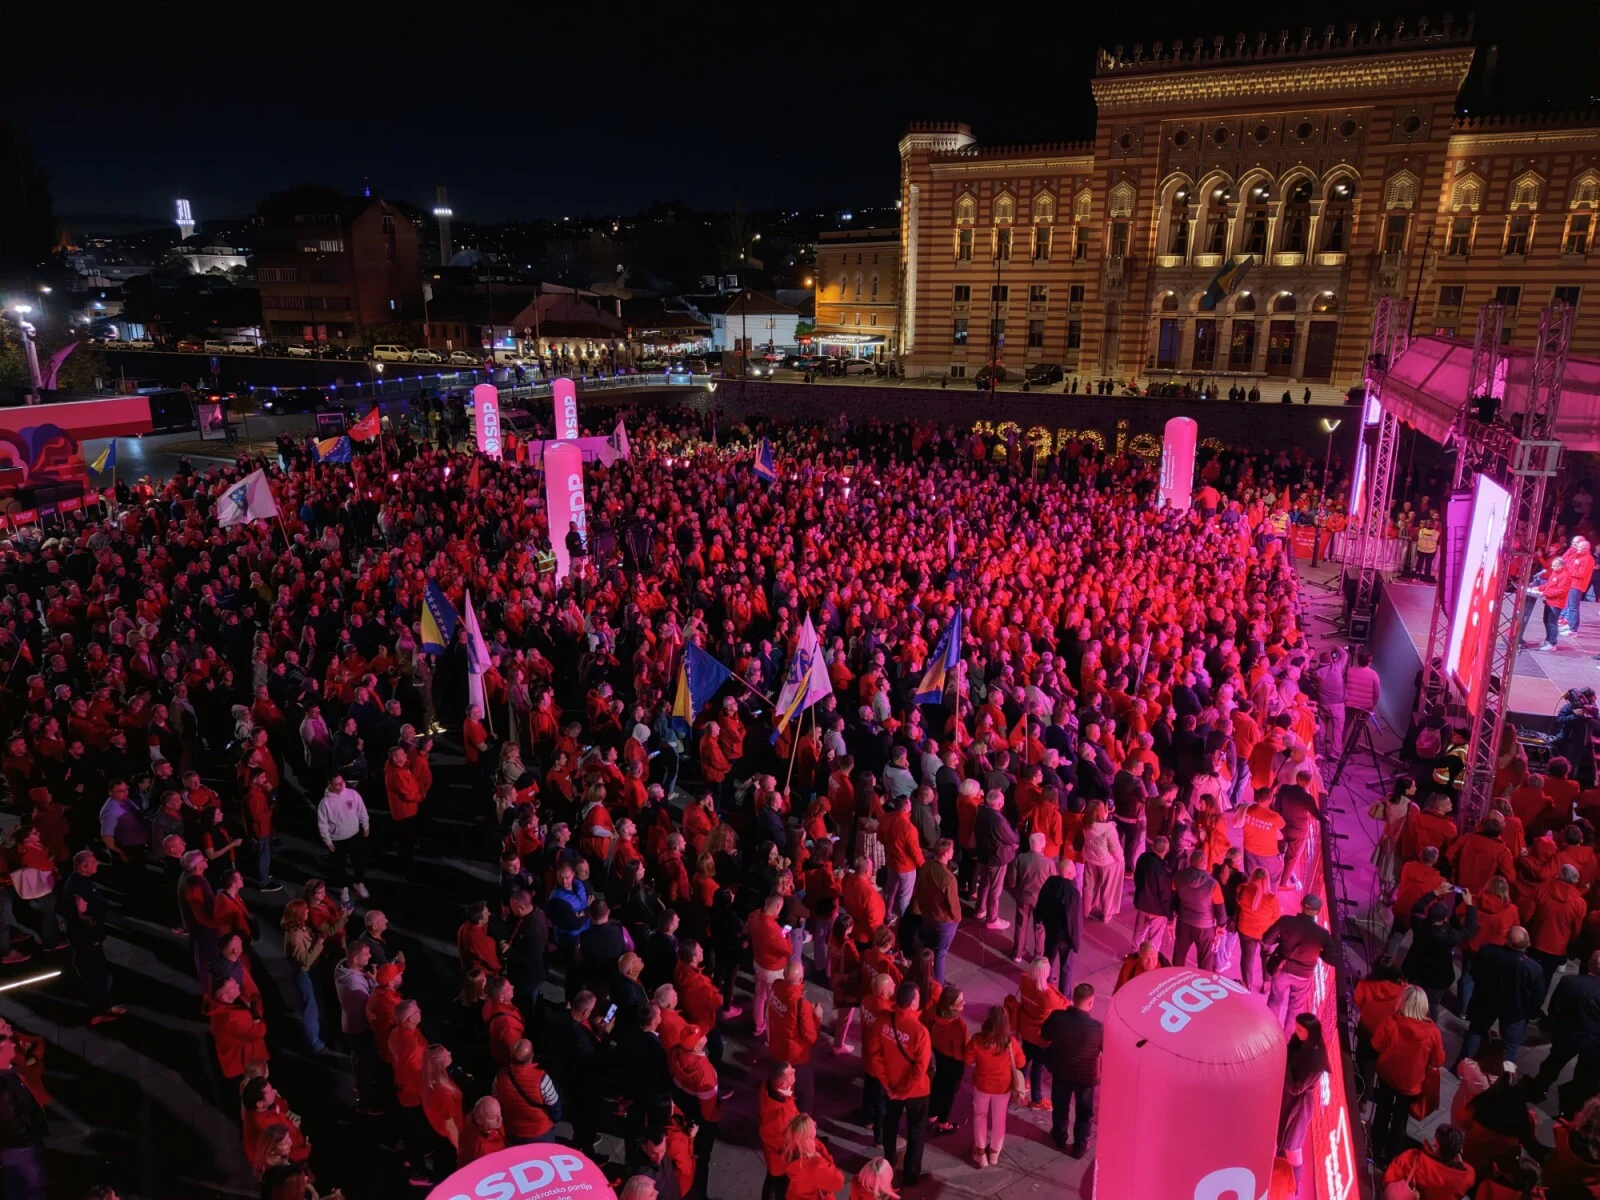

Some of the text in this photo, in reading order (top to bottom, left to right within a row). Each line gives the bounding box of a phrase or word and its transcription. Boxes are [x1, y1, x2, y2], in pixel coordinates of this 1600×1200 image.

[483, 402, 498, 437] SDP
[564, 395, 577, 428] SDP
[568, 473, 586, 529] SDP
[1159, 977, 1229, 1033] SDP
[475, 1154, 584, 1200] SDP
[567, 1182, 593, 1198] partija
